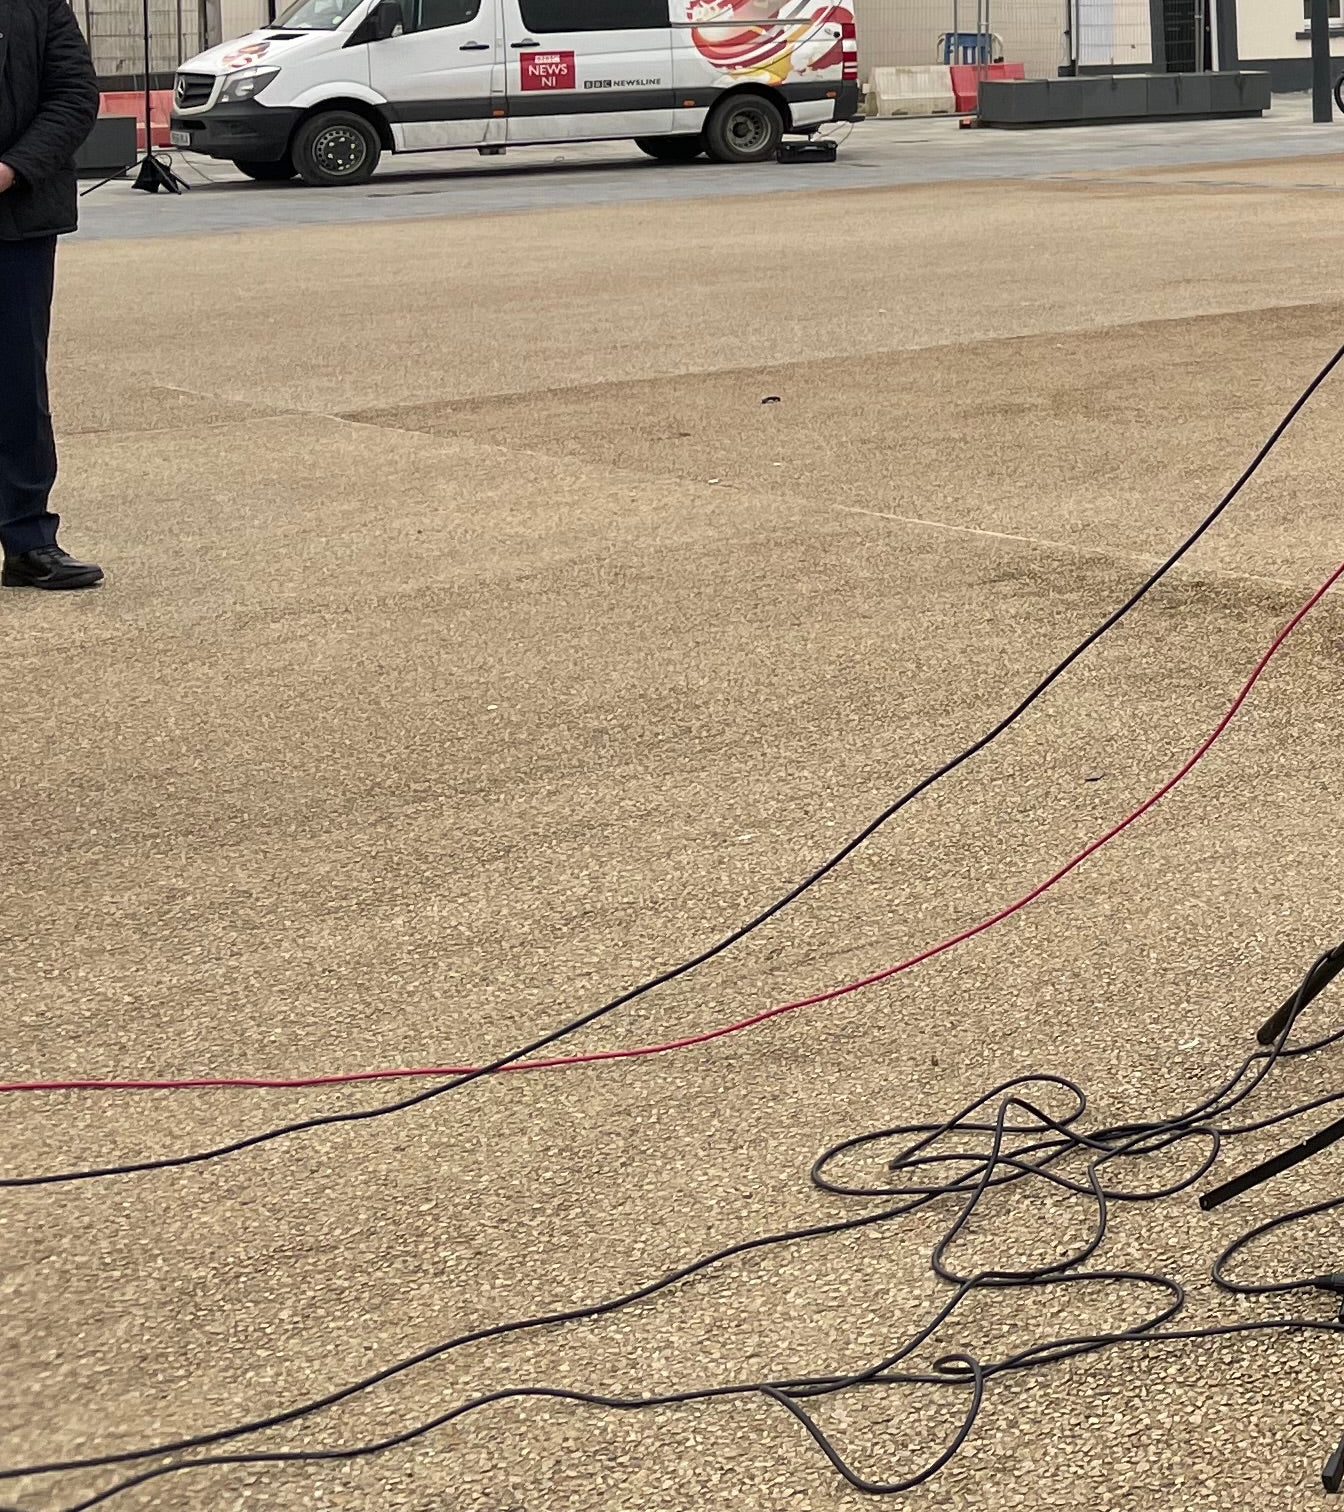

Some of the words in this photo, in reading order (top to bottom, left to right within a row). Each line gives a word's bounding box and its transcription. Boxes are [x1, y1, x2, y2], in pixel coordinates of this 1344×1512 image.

[528, 63, 568, 76] NEWS
[541, 76, 556, 87] NI
[583, 79, 612, 89] BBC
[613, 78, 661, 87] NEWSLINE
